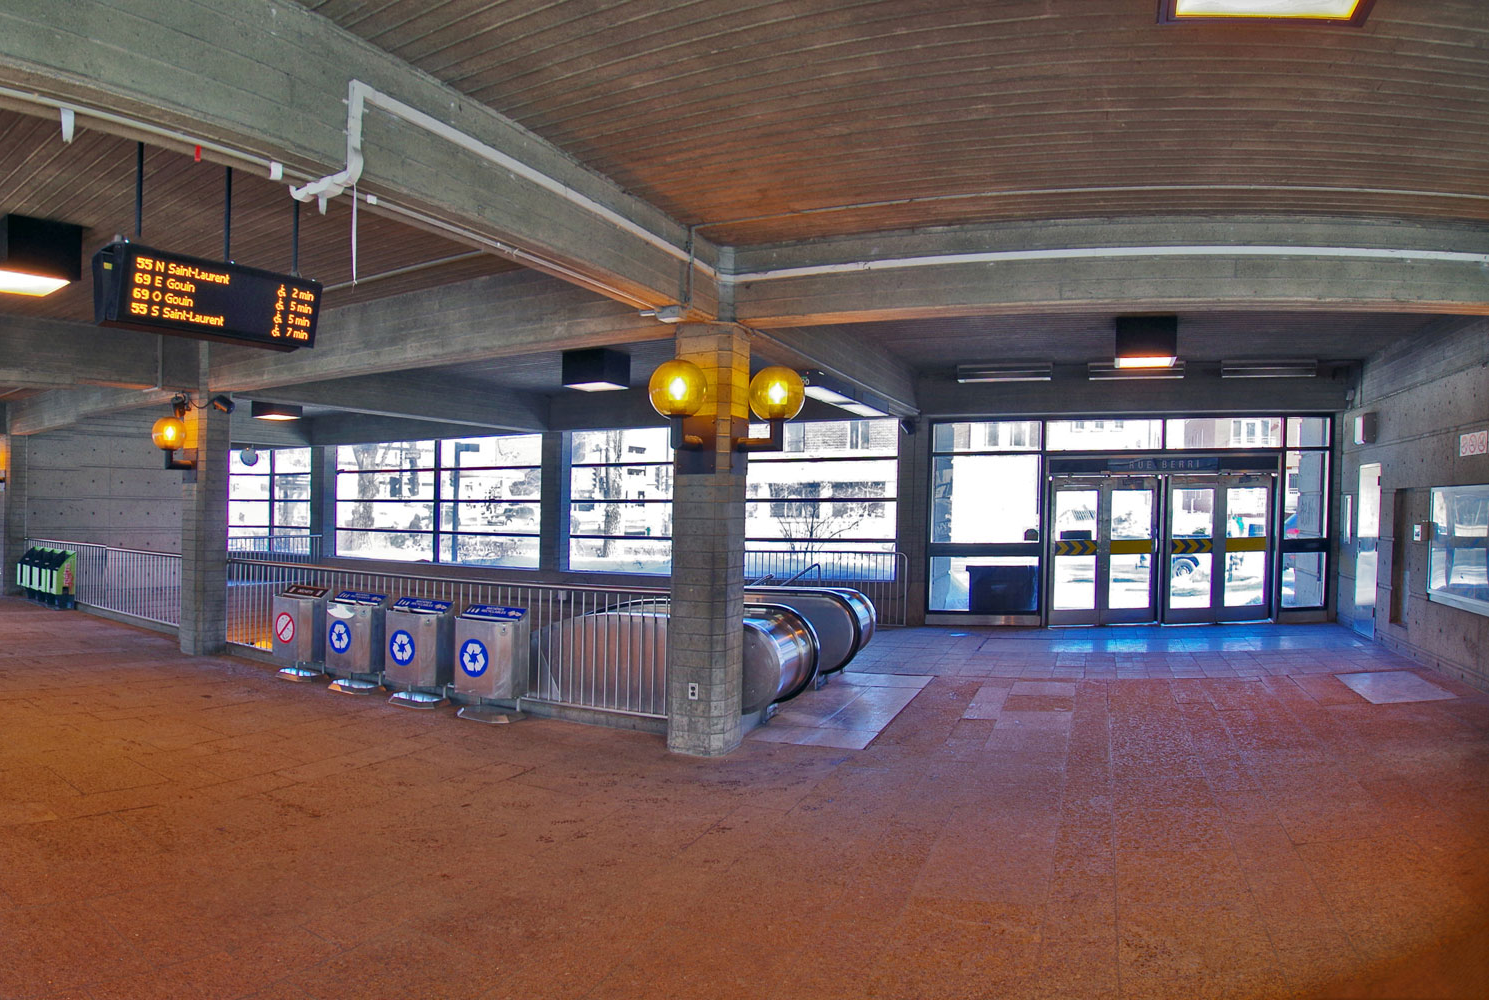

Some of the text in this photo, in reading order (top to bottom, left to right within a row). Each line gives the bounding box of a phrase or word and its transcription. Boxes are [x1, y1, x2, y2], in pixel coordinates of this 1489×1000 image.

[134, 272, 313, 315] 69 E Gouin 5 min
[136, 256, 315, 302] 55 N Saint-Laurent 2 min
[130, 302, 309, 340] 55 S Saint-Laurent 7 min
[132, 287, 310, 327] 69 O Gouin 5 min
[1128, 459, 1200, 469] RUE BERRI
